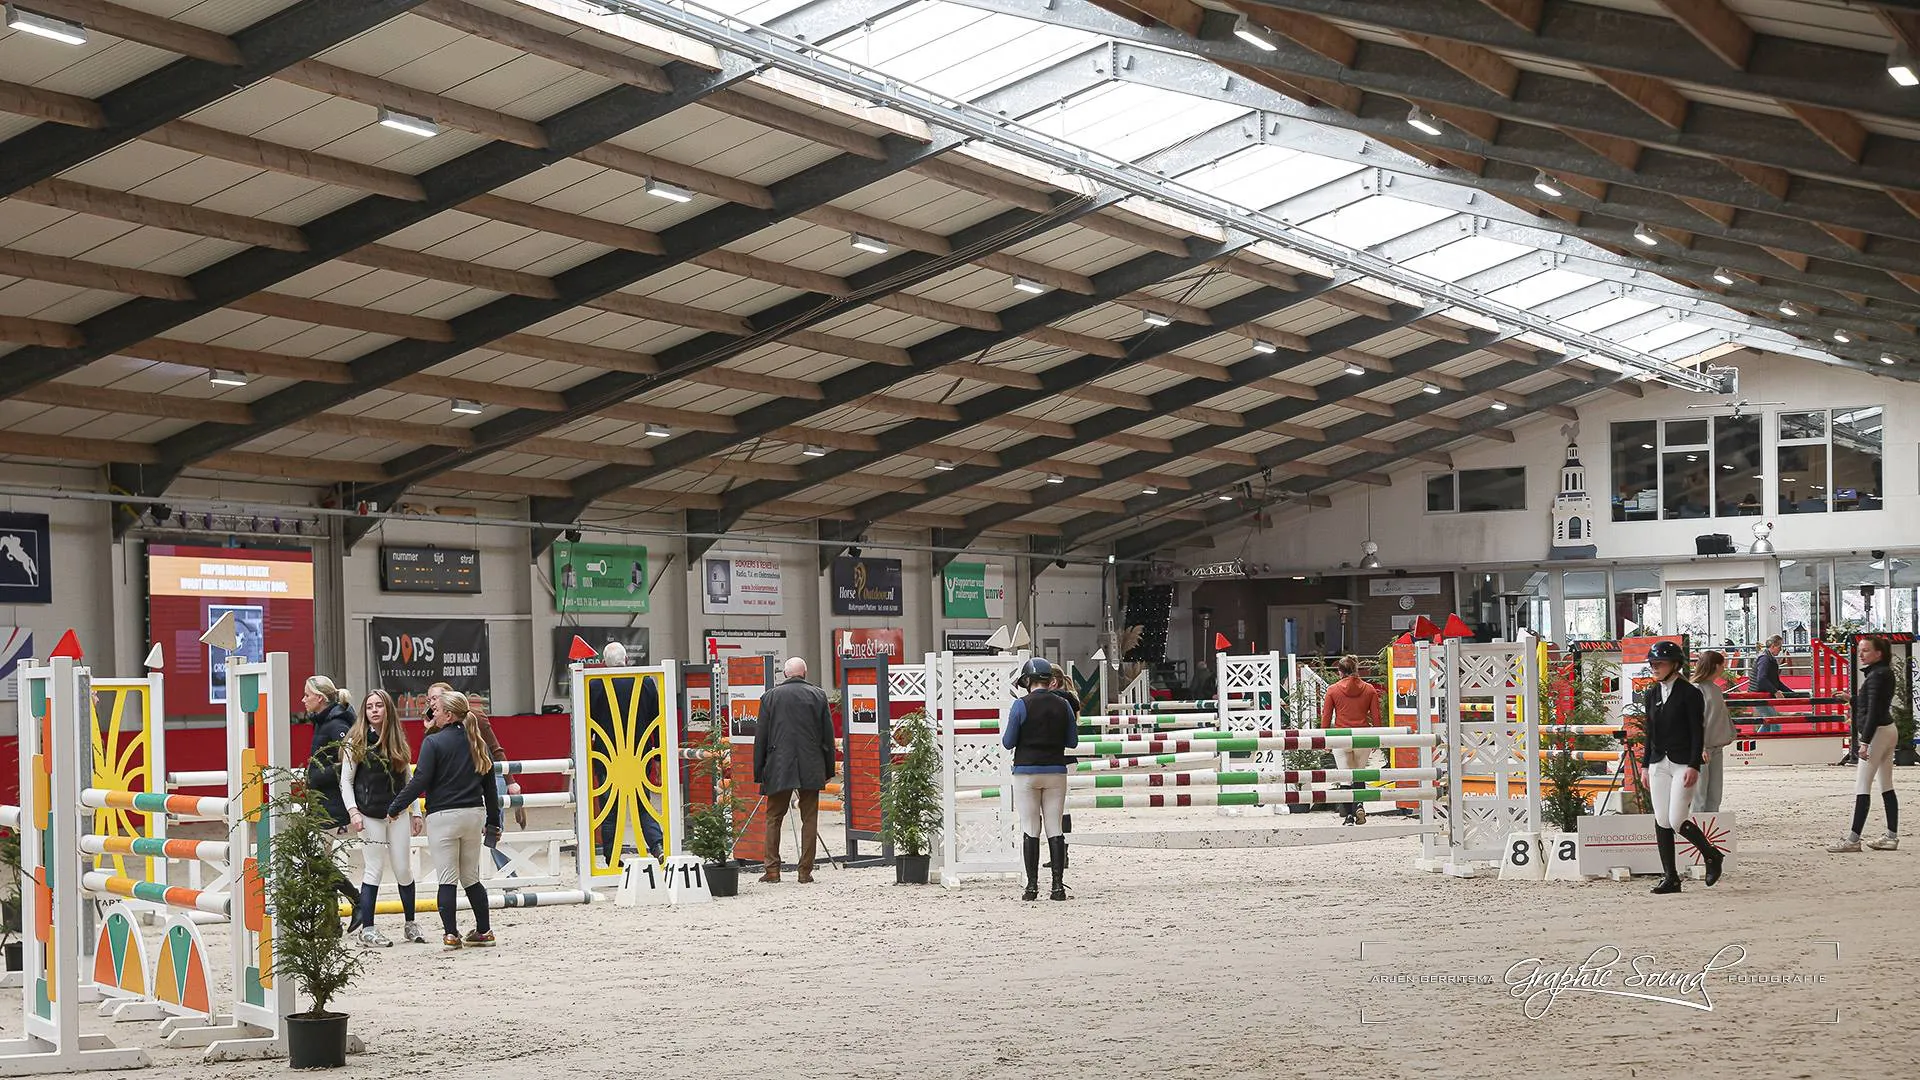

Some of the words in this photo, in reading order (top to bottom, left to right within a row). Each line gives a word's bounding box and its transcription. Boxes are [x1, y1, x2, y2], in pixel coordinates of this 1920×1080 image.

[392, 552, 418, 562] nummer
[433, 552, 445, 564] tijd
[460, 554, 474, 564] straf
[840, 586, 856, 599] Horse
[985, 585, 1004, 600] univé
[1511, 840, 1530, 866] 8
[1558, 840, 1577, 861] a
[642, 864, 656, 889] 1
[678, 863, 702, 888] 11
